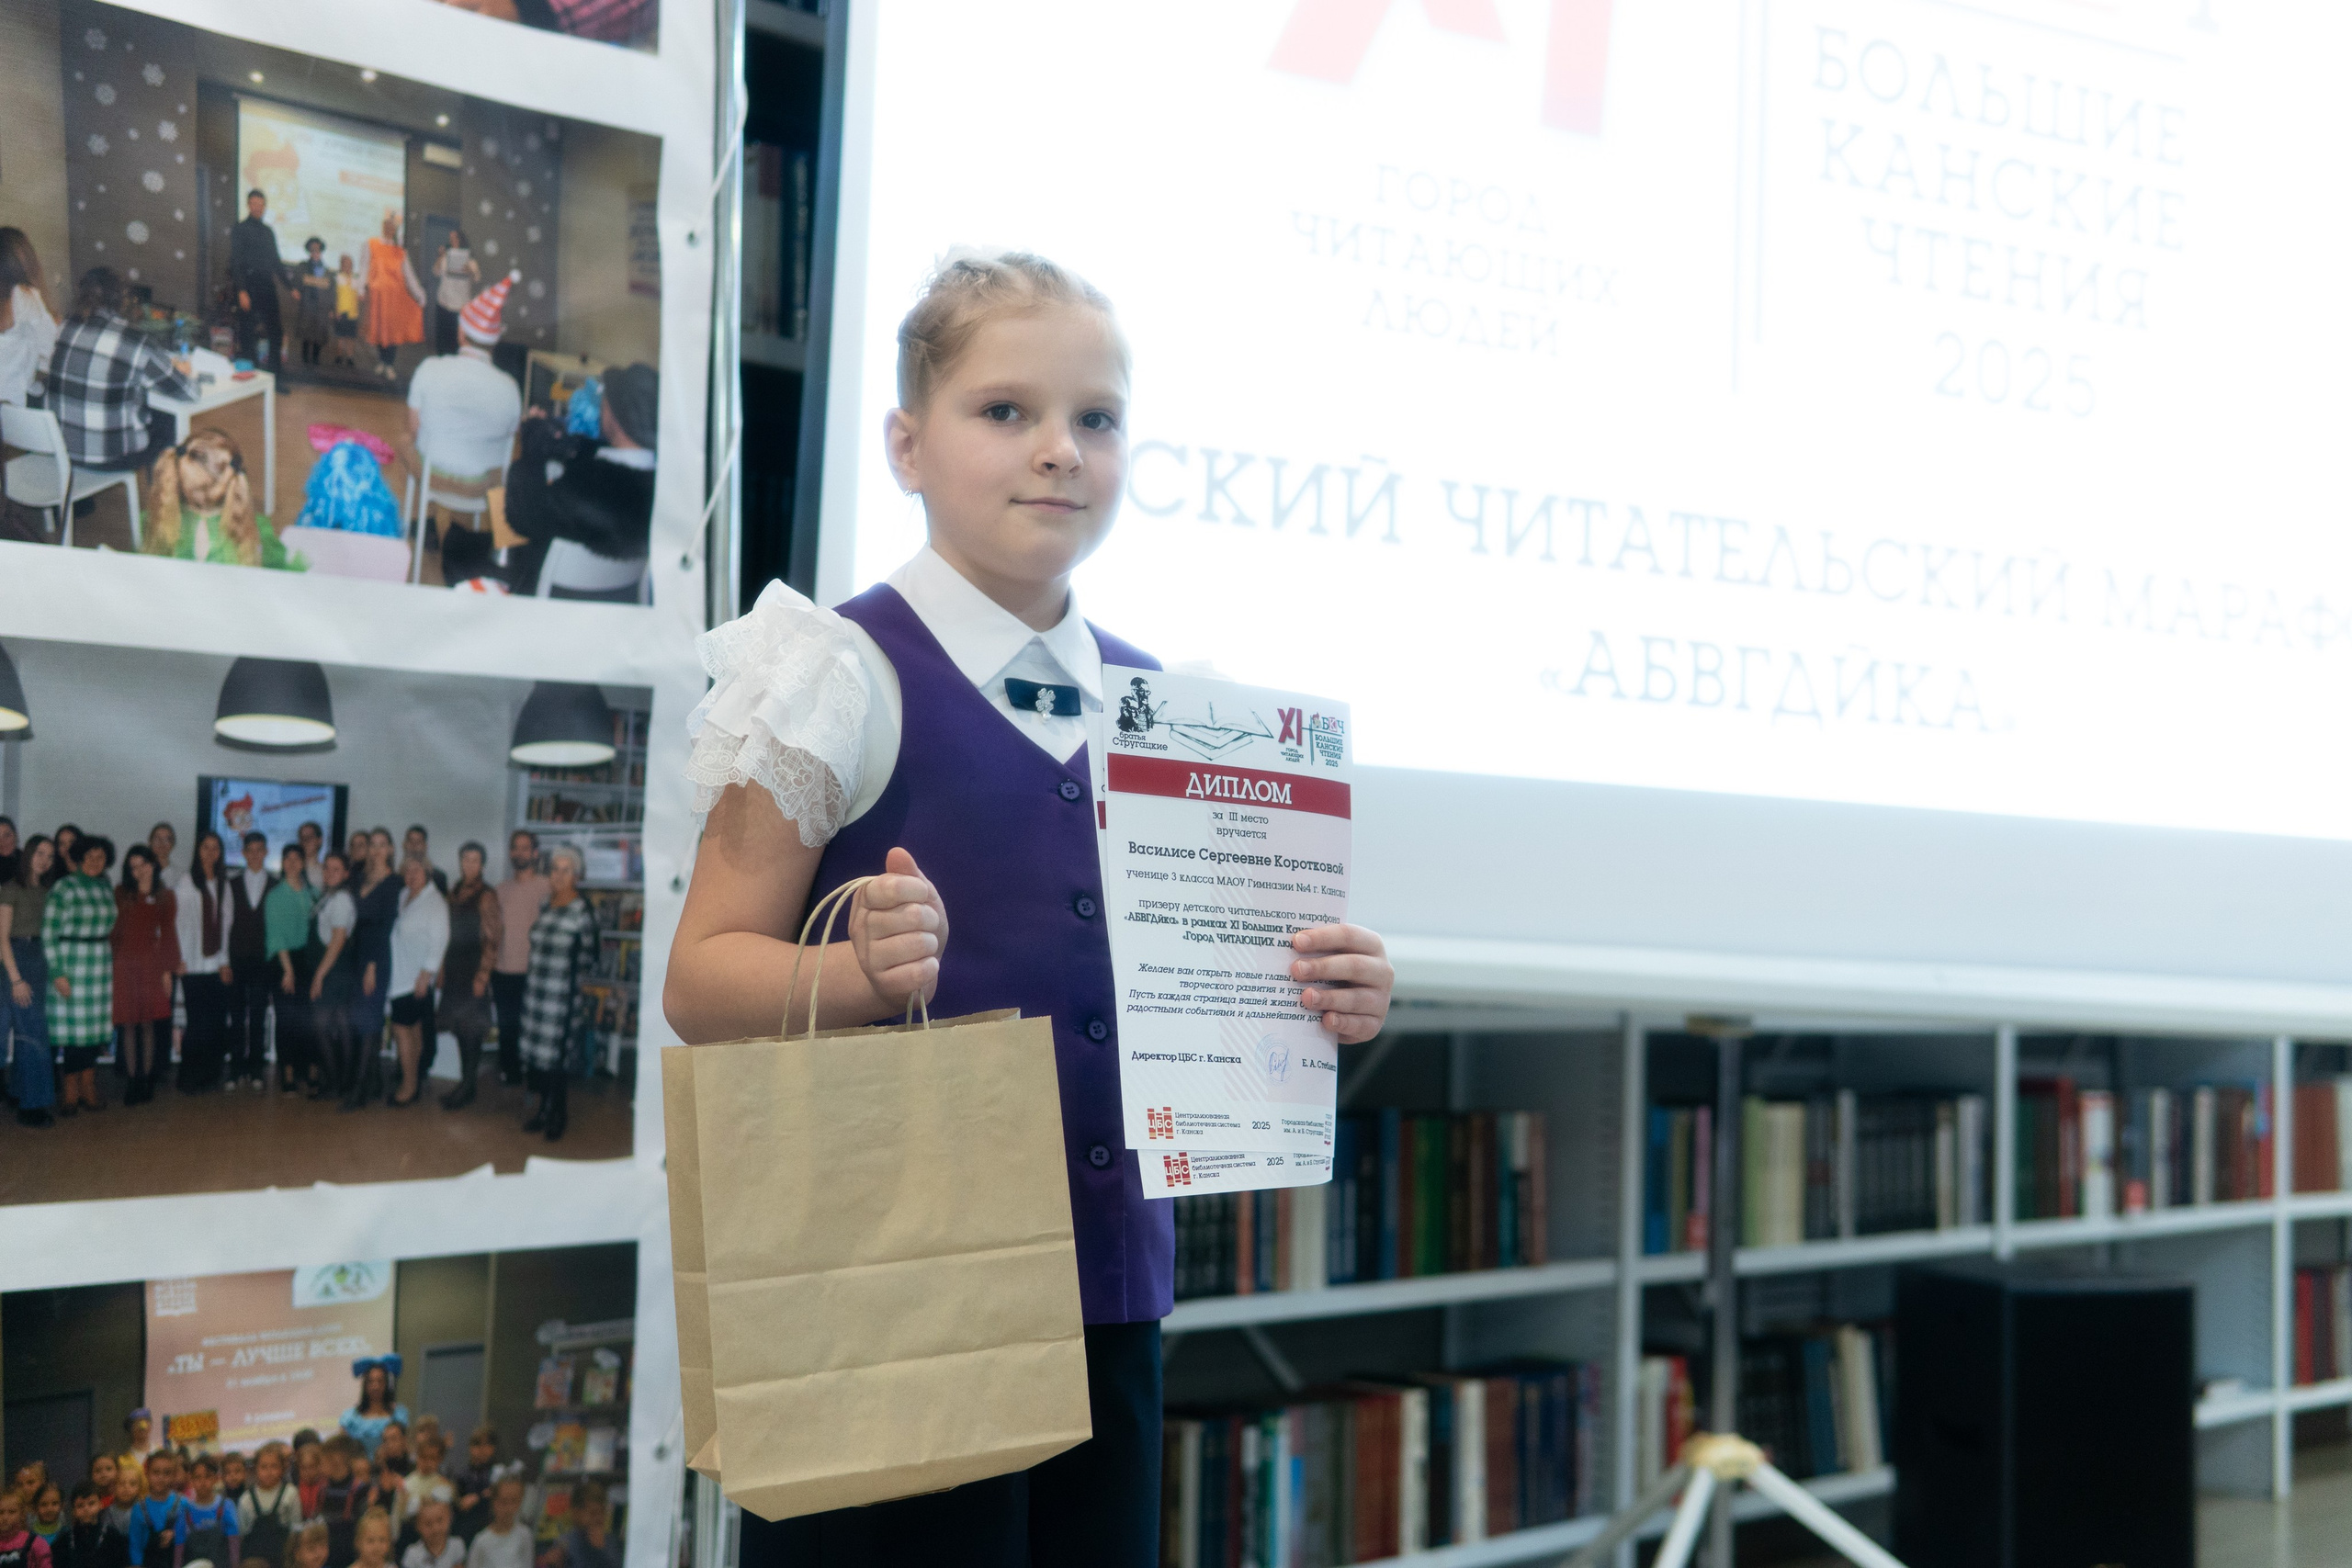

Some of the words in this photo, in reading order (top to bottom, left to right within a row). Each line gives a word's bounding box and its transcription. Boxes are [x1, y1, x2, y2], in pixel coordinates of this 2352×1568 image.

[1813, 24, 2187, 167] БОЛЬШИЕ
[1820, 117, 2187, 253] КАНСКИЕ
[1376, 163, 1547, 237] ГОРОД
[1289, 209, 1619, 308] ЧИТАЮЩИХ
[1860, 215, 2150, 330] ЧТЕНИЯ
[1932, 331, 2096, 417] 2025
[1127, 439, 1404, 544] СКИЙ
[1439, 479, 2070, 624] ЧИТАТЕЛЬСКИЙ
[2102, 567, 2352, 651] МАРАФ
[1277, 707, 1302, 746] XI
[1113, 737, 1168, 750] Стругацкие
[1119, 731, 1146, 741] братья
[1315, 734, 1343, 746] БОЛЬШИЕ
[1316, 741, 1344, 753] КАНСКИЕ
[1319, 750, 1342, 760] ЧТЕНИЯ
[1326, 759, 1338, 767] 2025
[1185, 772, 1292, 805] ДИПЛОМ
[1212, 811, 1223, 820] за
[1241, 814, 1269, 825] место
[1216, 827, 1267, 840] вручается
[1128, 840, 1195, 860] Василисе
[1199, 849, 1272, 866] Сергеевне
[1274, 855, 1344, 874] Коротковой
[1126, 869, 1169, 882] ученице
[1171, 872, 1177, 881] 3
[1180, 874, 1215, 885] класса
[1216, 876, 1245, 887] МАОУ
[1248, 879, 1294, 892] Гимназии
[1296, 883, 1311, 894] №4
[1313, 886, 1319, 894] г.
[1138, 899, 1180, 912] призеру
[1182, 902, 1225, 915] детского
[1227, 907, 1295, 919] читательского
[1192, 919, 1227, 930] рамках
[1242, 921, 1283, 933] Больших
[1182, 931, 1214, 943] «Город
[1216, 934, 1274, 946] ЧИТАЮЩИХ
[1138, 964, 1174, 975] Желаем
[1177, 966, 1193, 975] вам
[1196, 967, 1232, 979] открыть
[1235, 971, 1261, 979] новые
[1264, 973, 1291, 982] главы
[1179, 980, 1233, 992] творческого
[1236, 983, 1276, 995] развития
[1129, 989, 1155, 1001] Пусть
[1158, 992, 1191, 1004] каждая
[1193, 995, 1236, 1006] страница
[1238, 998, 1268, 1007] вашей
[1270, 999, 1297, 1008] жизни
[1126, 1003, 1182, 1016] радостными
[1185, 1006, 1235, 1018] событиями
[1246, 1010, 1305, 1021] дальнейшими
[1132, 1051, 1177, 1064] Директор
[1178, 1053, 1197, 1063] ЦБС
[1207, 1054, 1241, 1064] Канска
[1252, 1121, 1271, 1130] 2025
[1267, 1157, 1283, 1166] 2025
